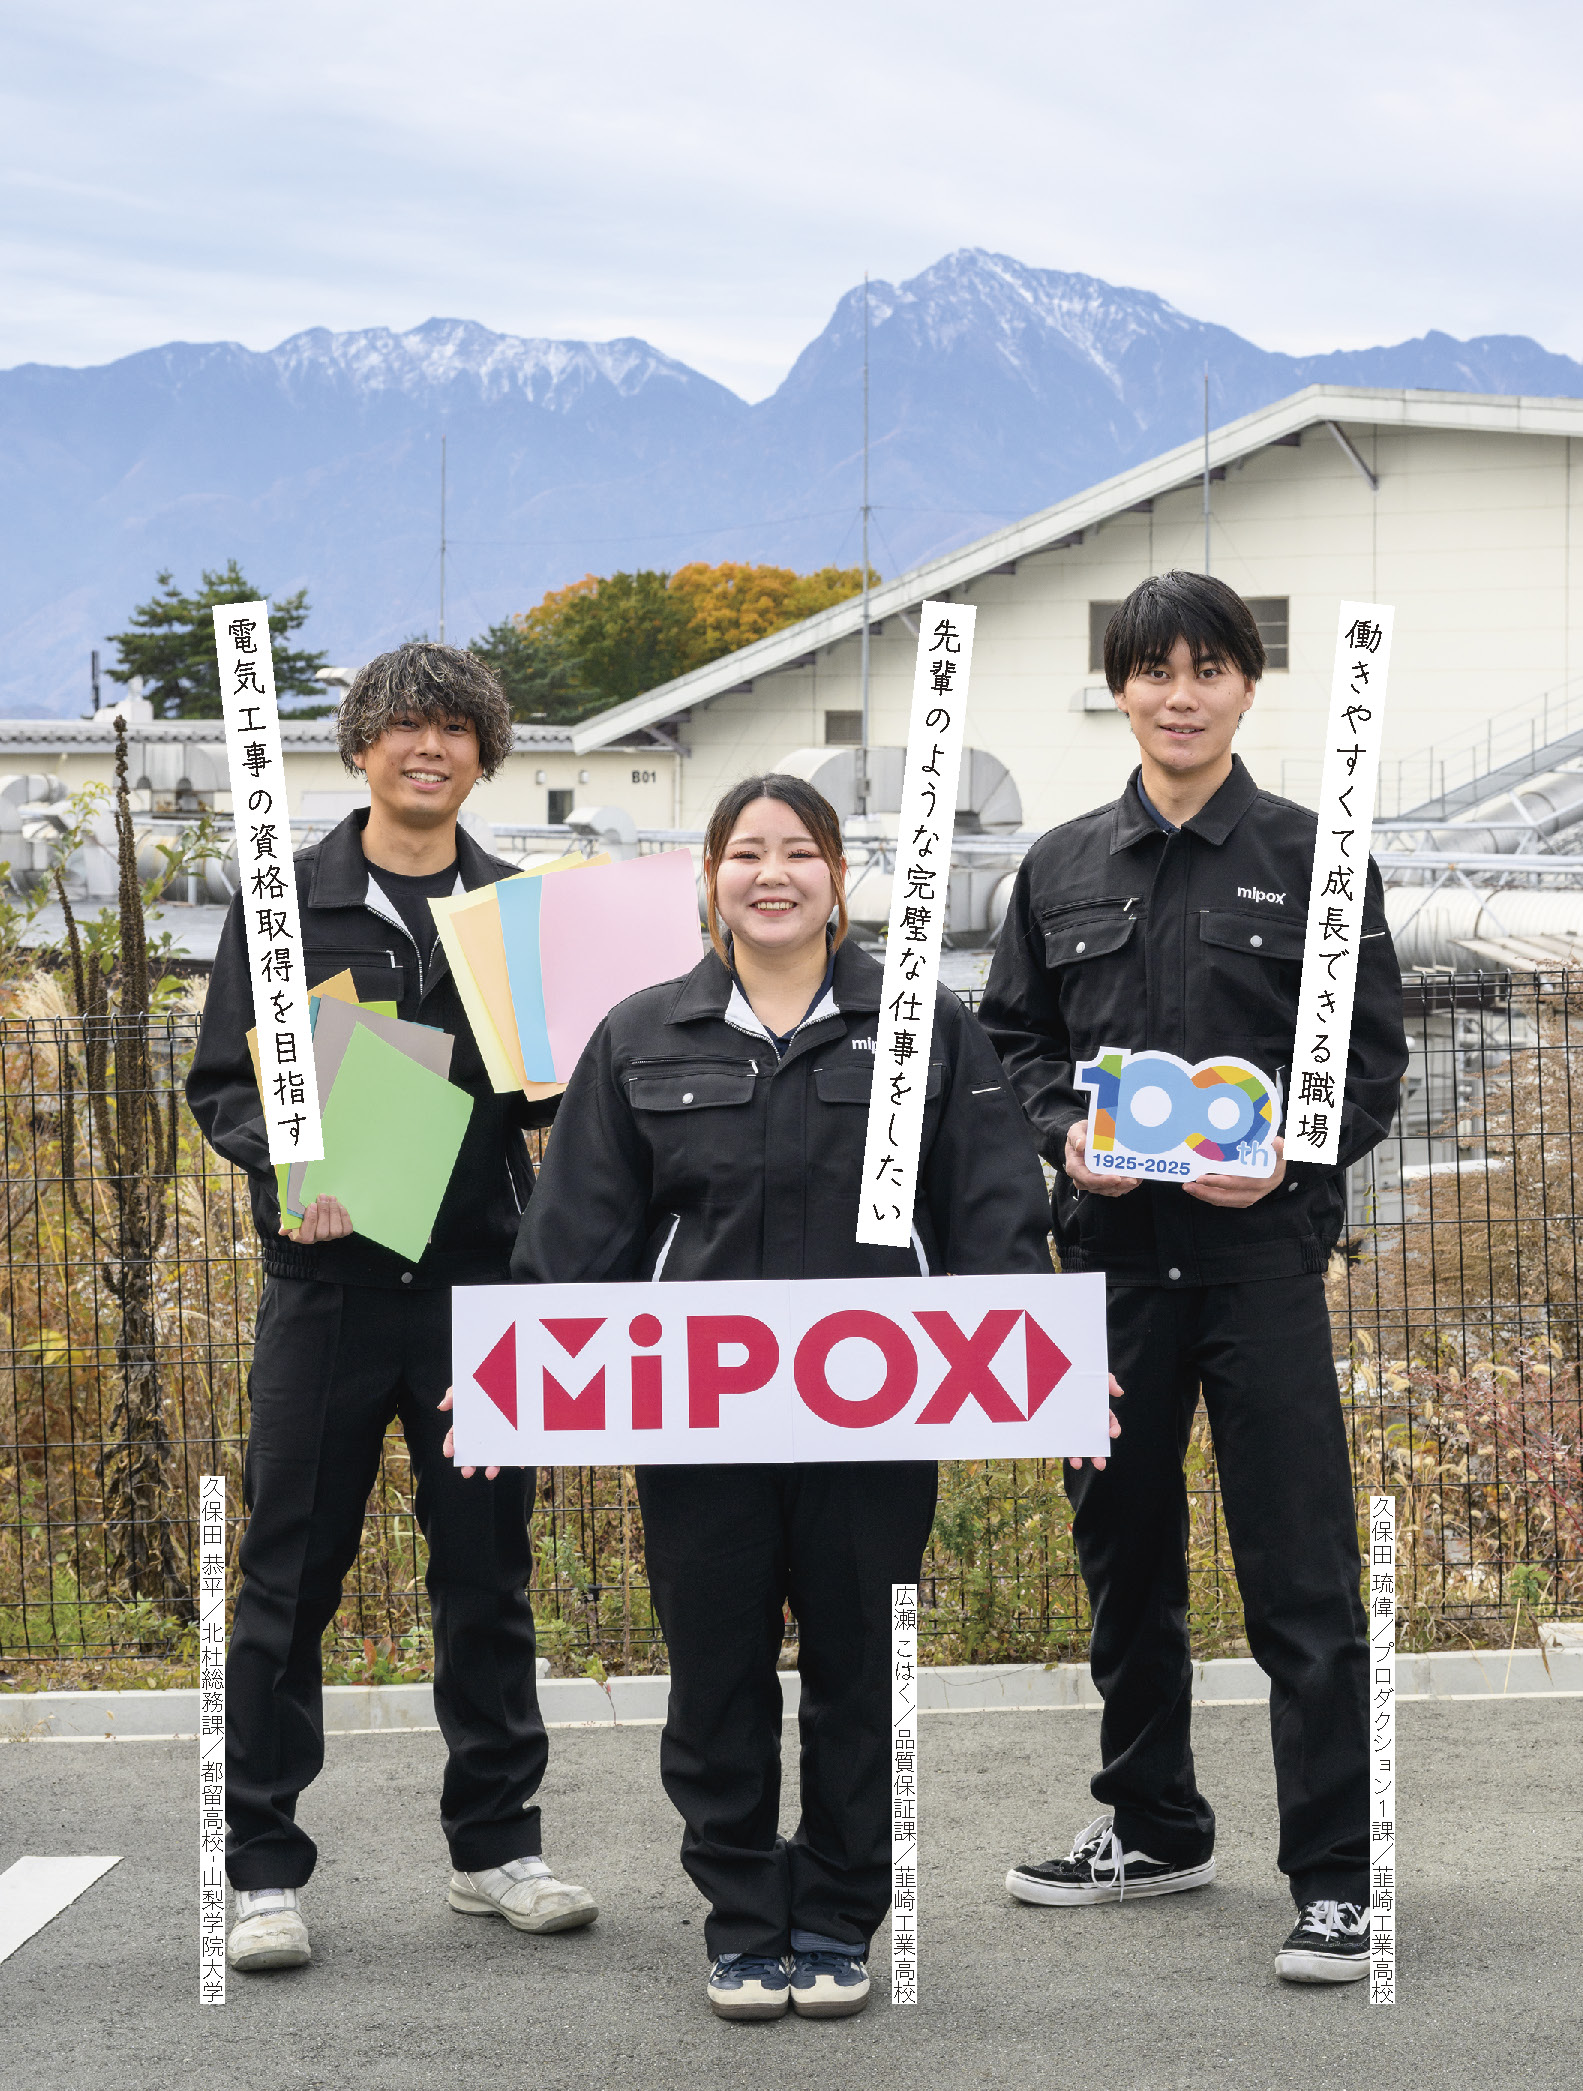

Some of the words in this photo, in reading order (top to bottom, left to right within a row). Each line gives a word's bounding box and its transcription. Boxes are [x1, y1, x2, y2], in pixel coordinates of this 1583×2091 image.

[631, 770, 657, 784] B01
[1237, 886, 1287, 905] mipox
[1092, 1153, 1191, 1176] 1925-2025
